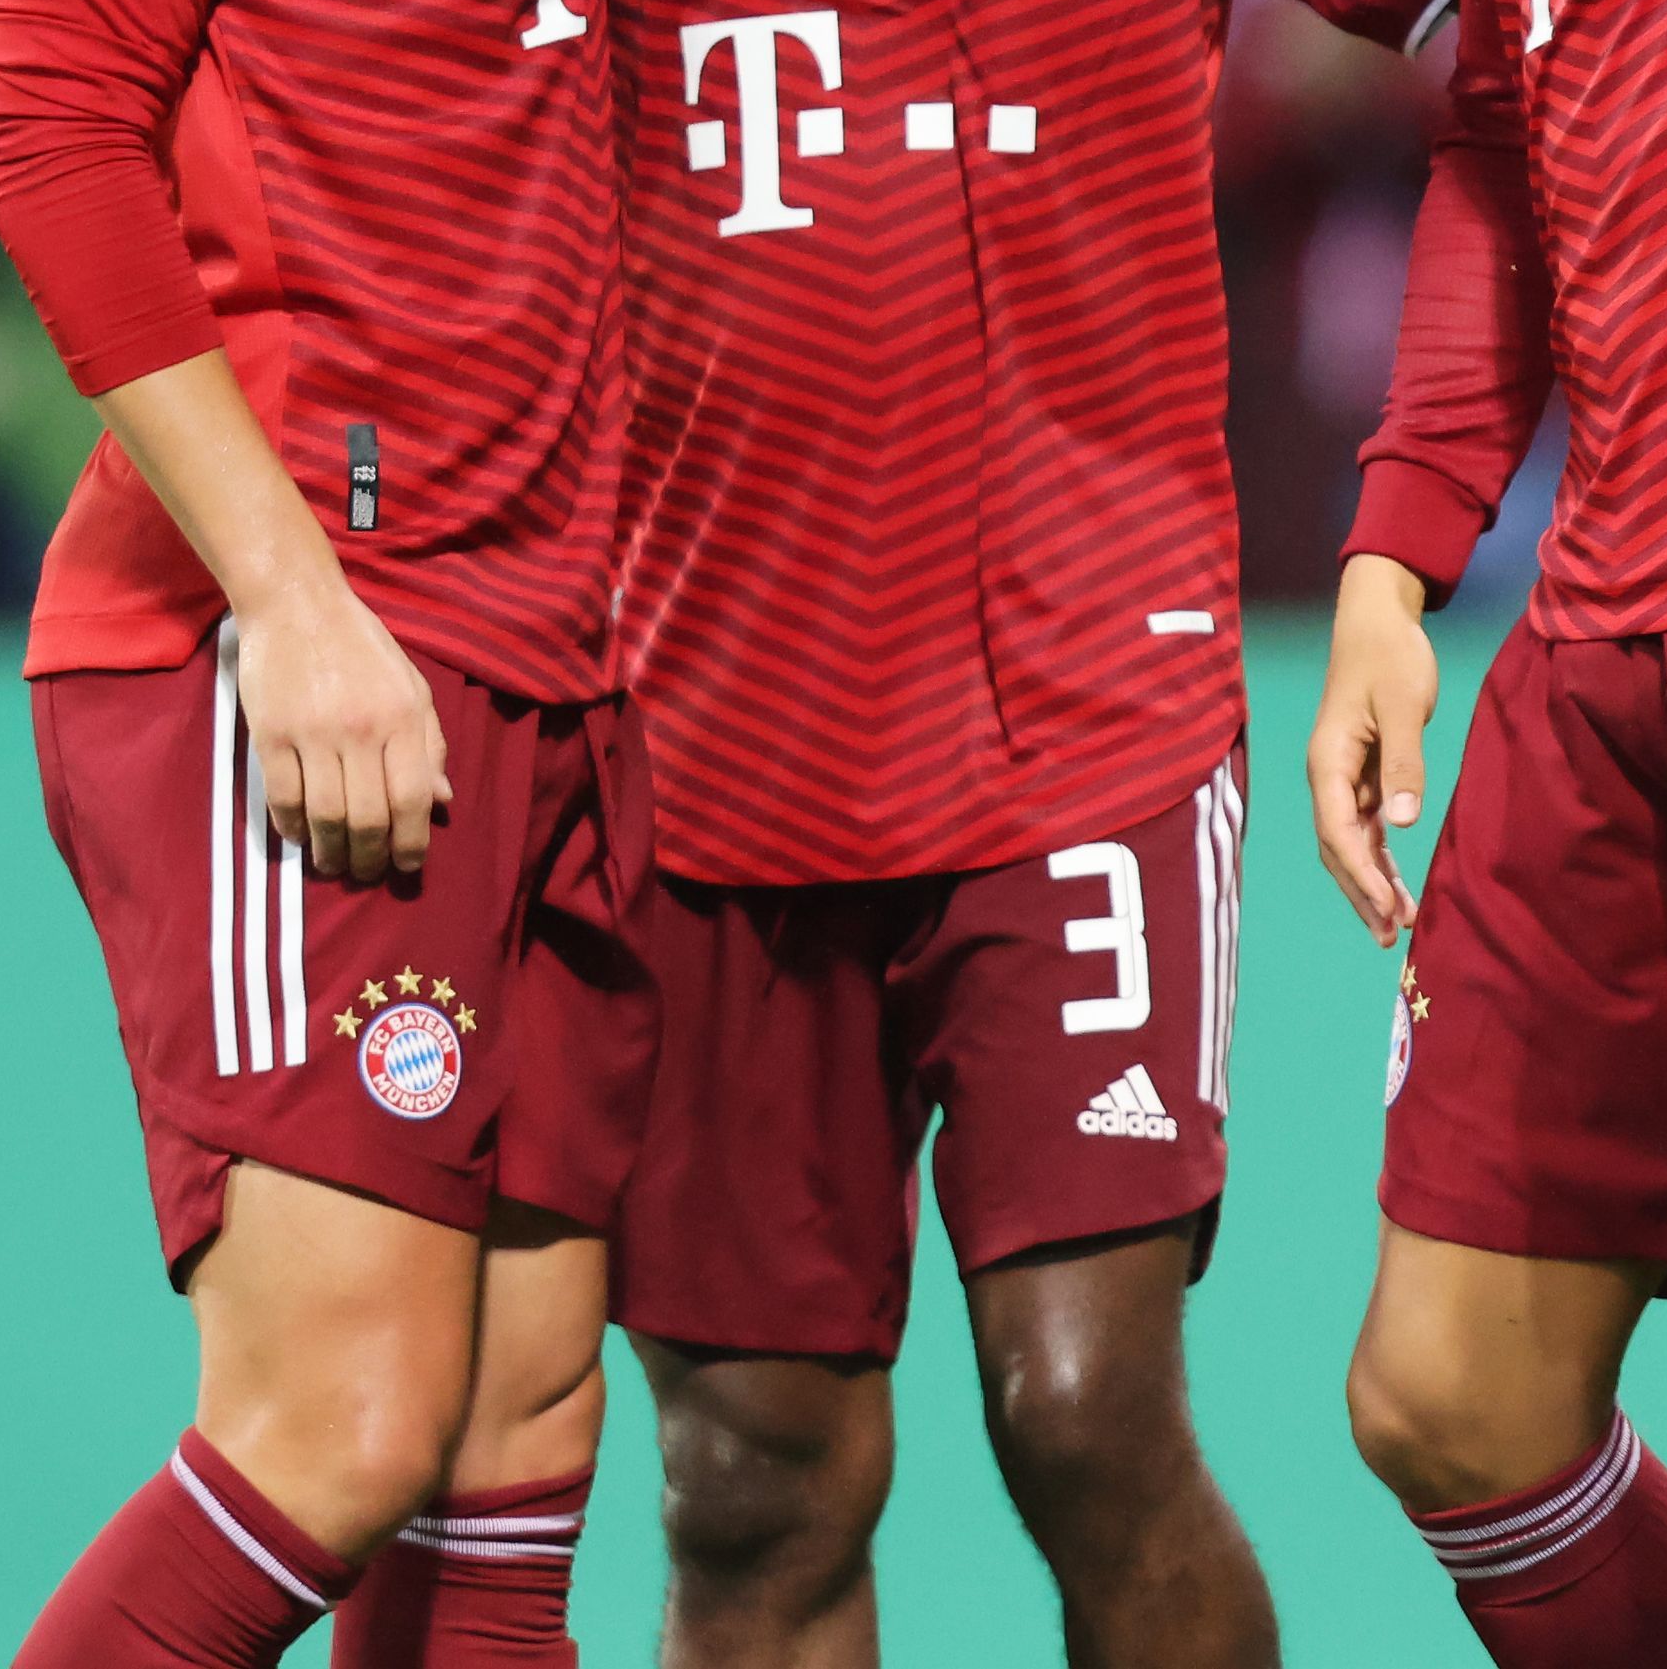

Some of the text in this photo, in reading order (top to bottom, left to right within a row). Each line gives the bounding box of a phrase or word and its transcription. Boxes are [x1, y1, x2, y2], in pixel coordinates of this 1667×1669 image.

[1048, 841, 1151, 1035] 3
[368, 1011, 455, 1055] FC BAYERN
[1076, 1109, 1178, 1142] adidas
